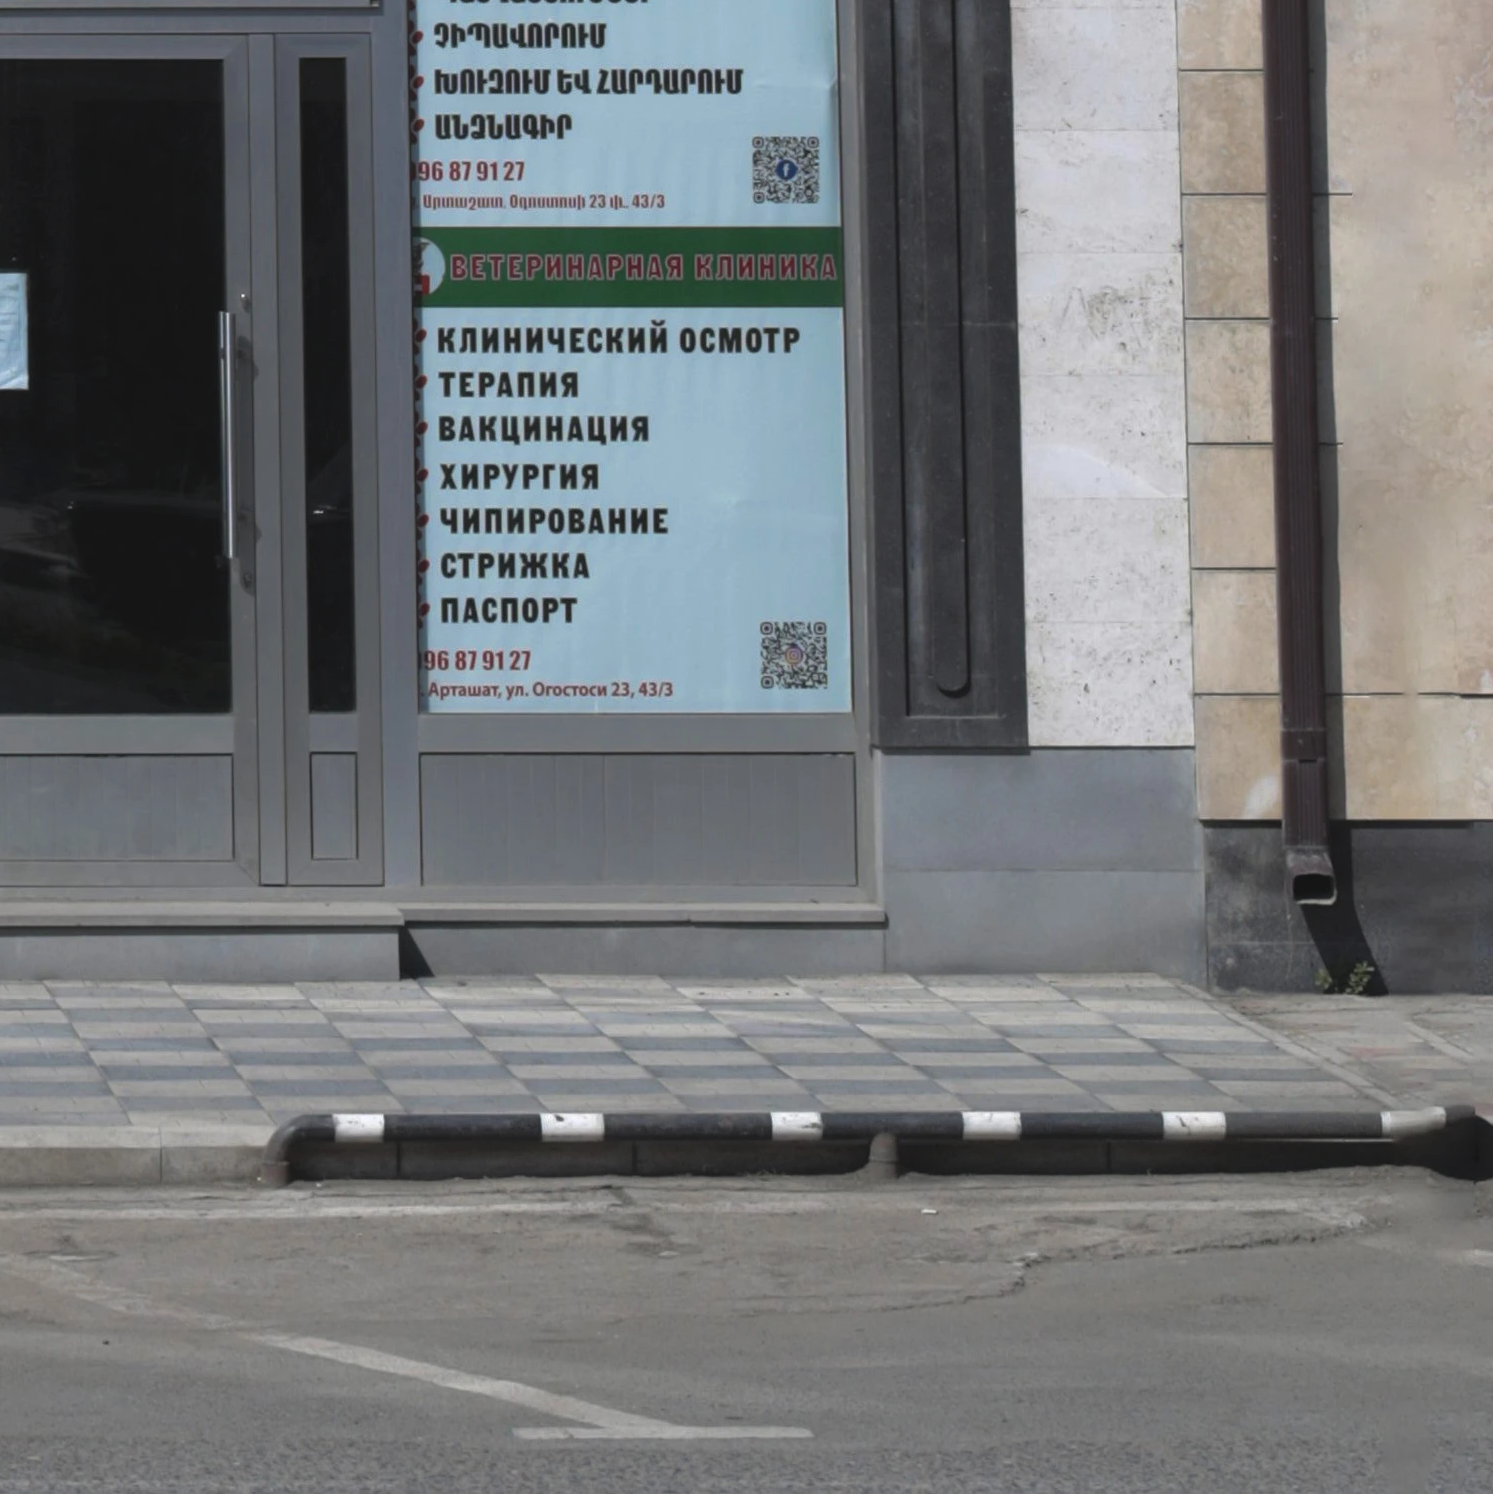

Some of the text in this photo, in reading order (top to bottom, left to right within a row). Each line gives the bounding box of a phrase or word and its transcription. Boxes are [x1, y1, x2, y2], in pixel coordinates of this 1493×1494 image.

[434, 23, 607, 50] ՉԻՊԱՎՈՐՈՒՄ
[434, 69, 744, 95] ԽՈՒԶՈՒՄ ԵՎ ՀԱՐԴԱՐՈՒՄ
[434, 114, 573, 140] ԱՆՁՆԱԳԻՐ
[449, 160, 471, 182] 87
[476, 160, 499, 182] 91
[503, 160, 526, 182] 27
[589, 195, 606, 209] 23
[631, 195, 666, 209] 43/3
[450, 254, 838, 281] ВЕТЕРИНАРНАЯ КЛИНИКА
[437, 320, 801, 354] КЛИНИЧЕСКИЙ ОСМОТР
[438, 371, 579, 398] ТЕРАПИЯ
[438, 416, 650, 446] ВАКЦИНАЦИЯ
[440, 464, 600, 491] ХИРУРГИЯ
[440, 508, 669, 535] ЧИПИРОВАНИЕ
[440, 552, 591, 580] СТРИЖКА
[441, 597, 578, 623] ПАСПОРТ
[418, 650, 532, 671] 96 87 91 27
[428, 682, 673, 700] Арташат, ул. Огостоси 23, 43/3
